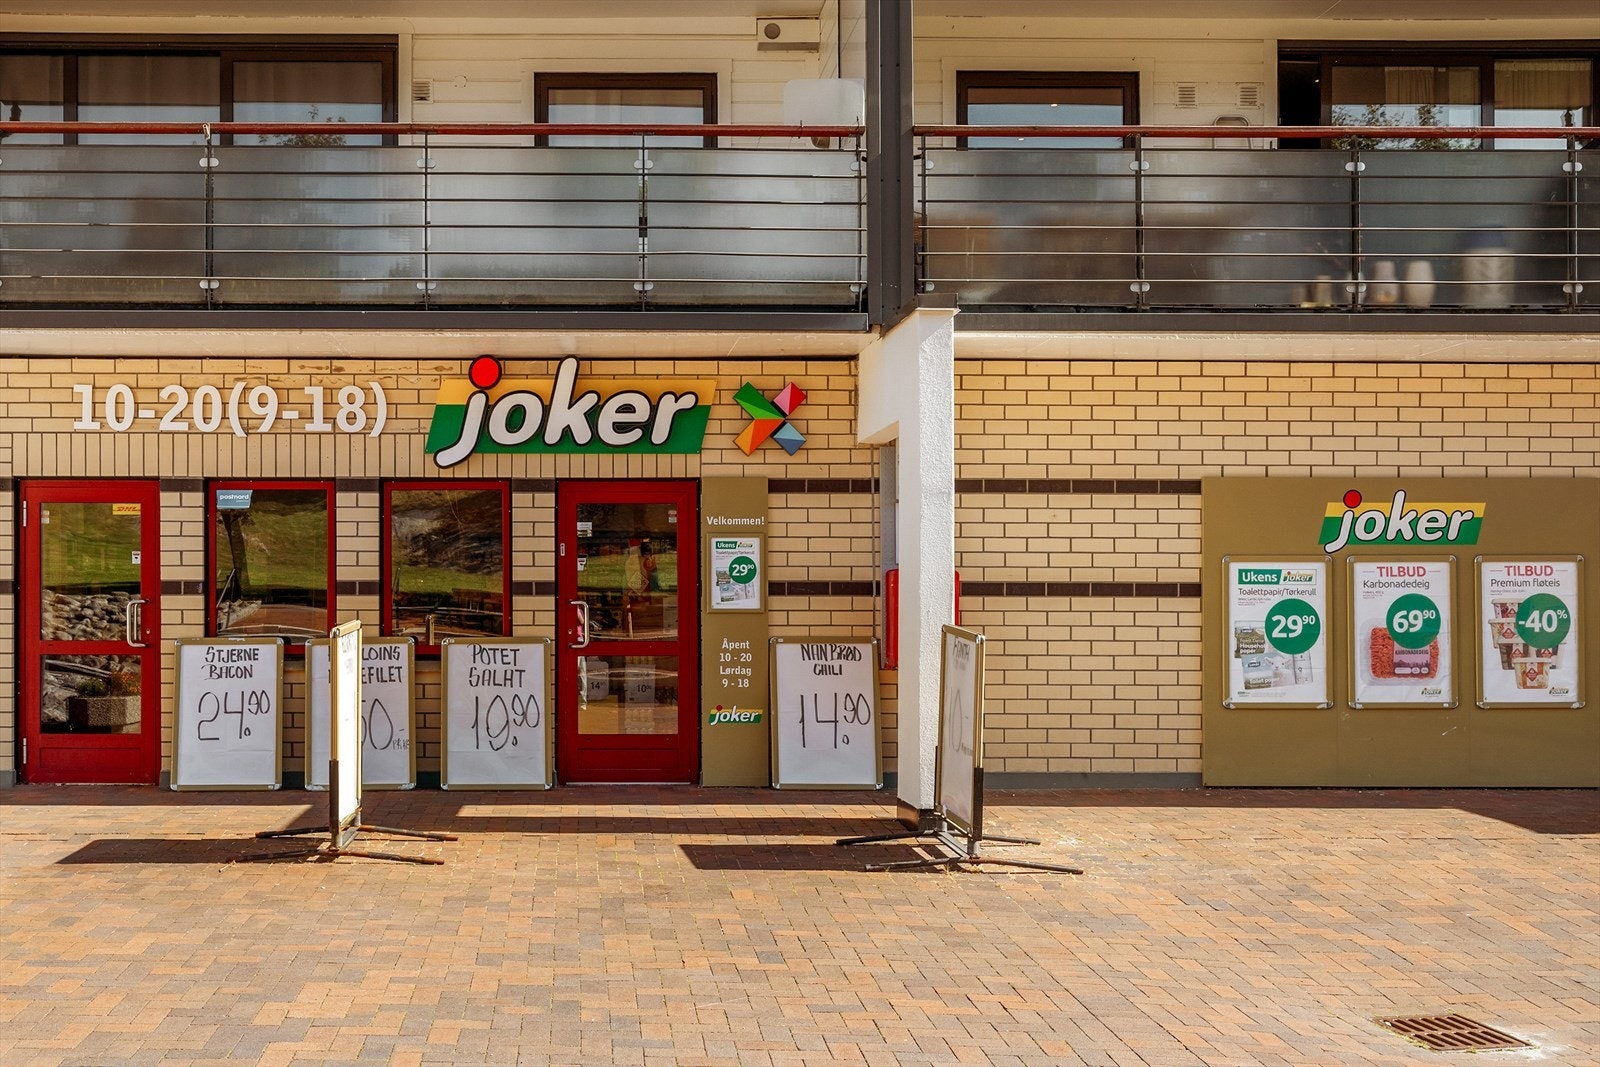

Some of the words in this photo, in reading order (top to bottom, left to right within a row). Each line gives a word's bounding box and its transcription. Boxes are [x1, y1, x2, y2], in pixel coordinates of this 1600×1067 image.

[73, 381, 387, 437] 10-20(9-18)
[433, 355, 699, 469] joker
[706, 516, 765, 525] Velkommen!
[1324, 489, 1474, 553] joker
[717, 541, 736, 549] Ukens
[1242, 571, 1278, 582] Ukens
[1284, 570, 1312, 583] joker
[1376, 566, 1427, 577] TILBUD
[1504, 565, 1554, 576] TILBUD
[1363, 579, 1430, 590] Karbonadedeig
[1490, 578, 1531, 588] Premium
[1532, 577, 1561, 588] fløteis
[1238, 587, 1317, 597] Toalettpapir/Tørkerull
[1518, 609, 1568, 633] -40%
[721, 637, 750, 650] Åpent
[204, 646, 260, 663] STJERNE
[362, 645, 400, 661] LOINS
[467, 643, 520, 666] POTET
[719, 652, 731, 662] 10
[740, 652, 752, 662] 20
[200, 664, 253, 680] BACON
[361, 666, 403, 684] EFILET
[719, 665, 752, 676] Lørdag
[813, 663, 842, 676] CHILI
[469, 667, 526, 688] SALAT
[722, 678, 728, 688] 9
[737, 678, 749, 688] 18
[710, 704, 759, 726] joker
